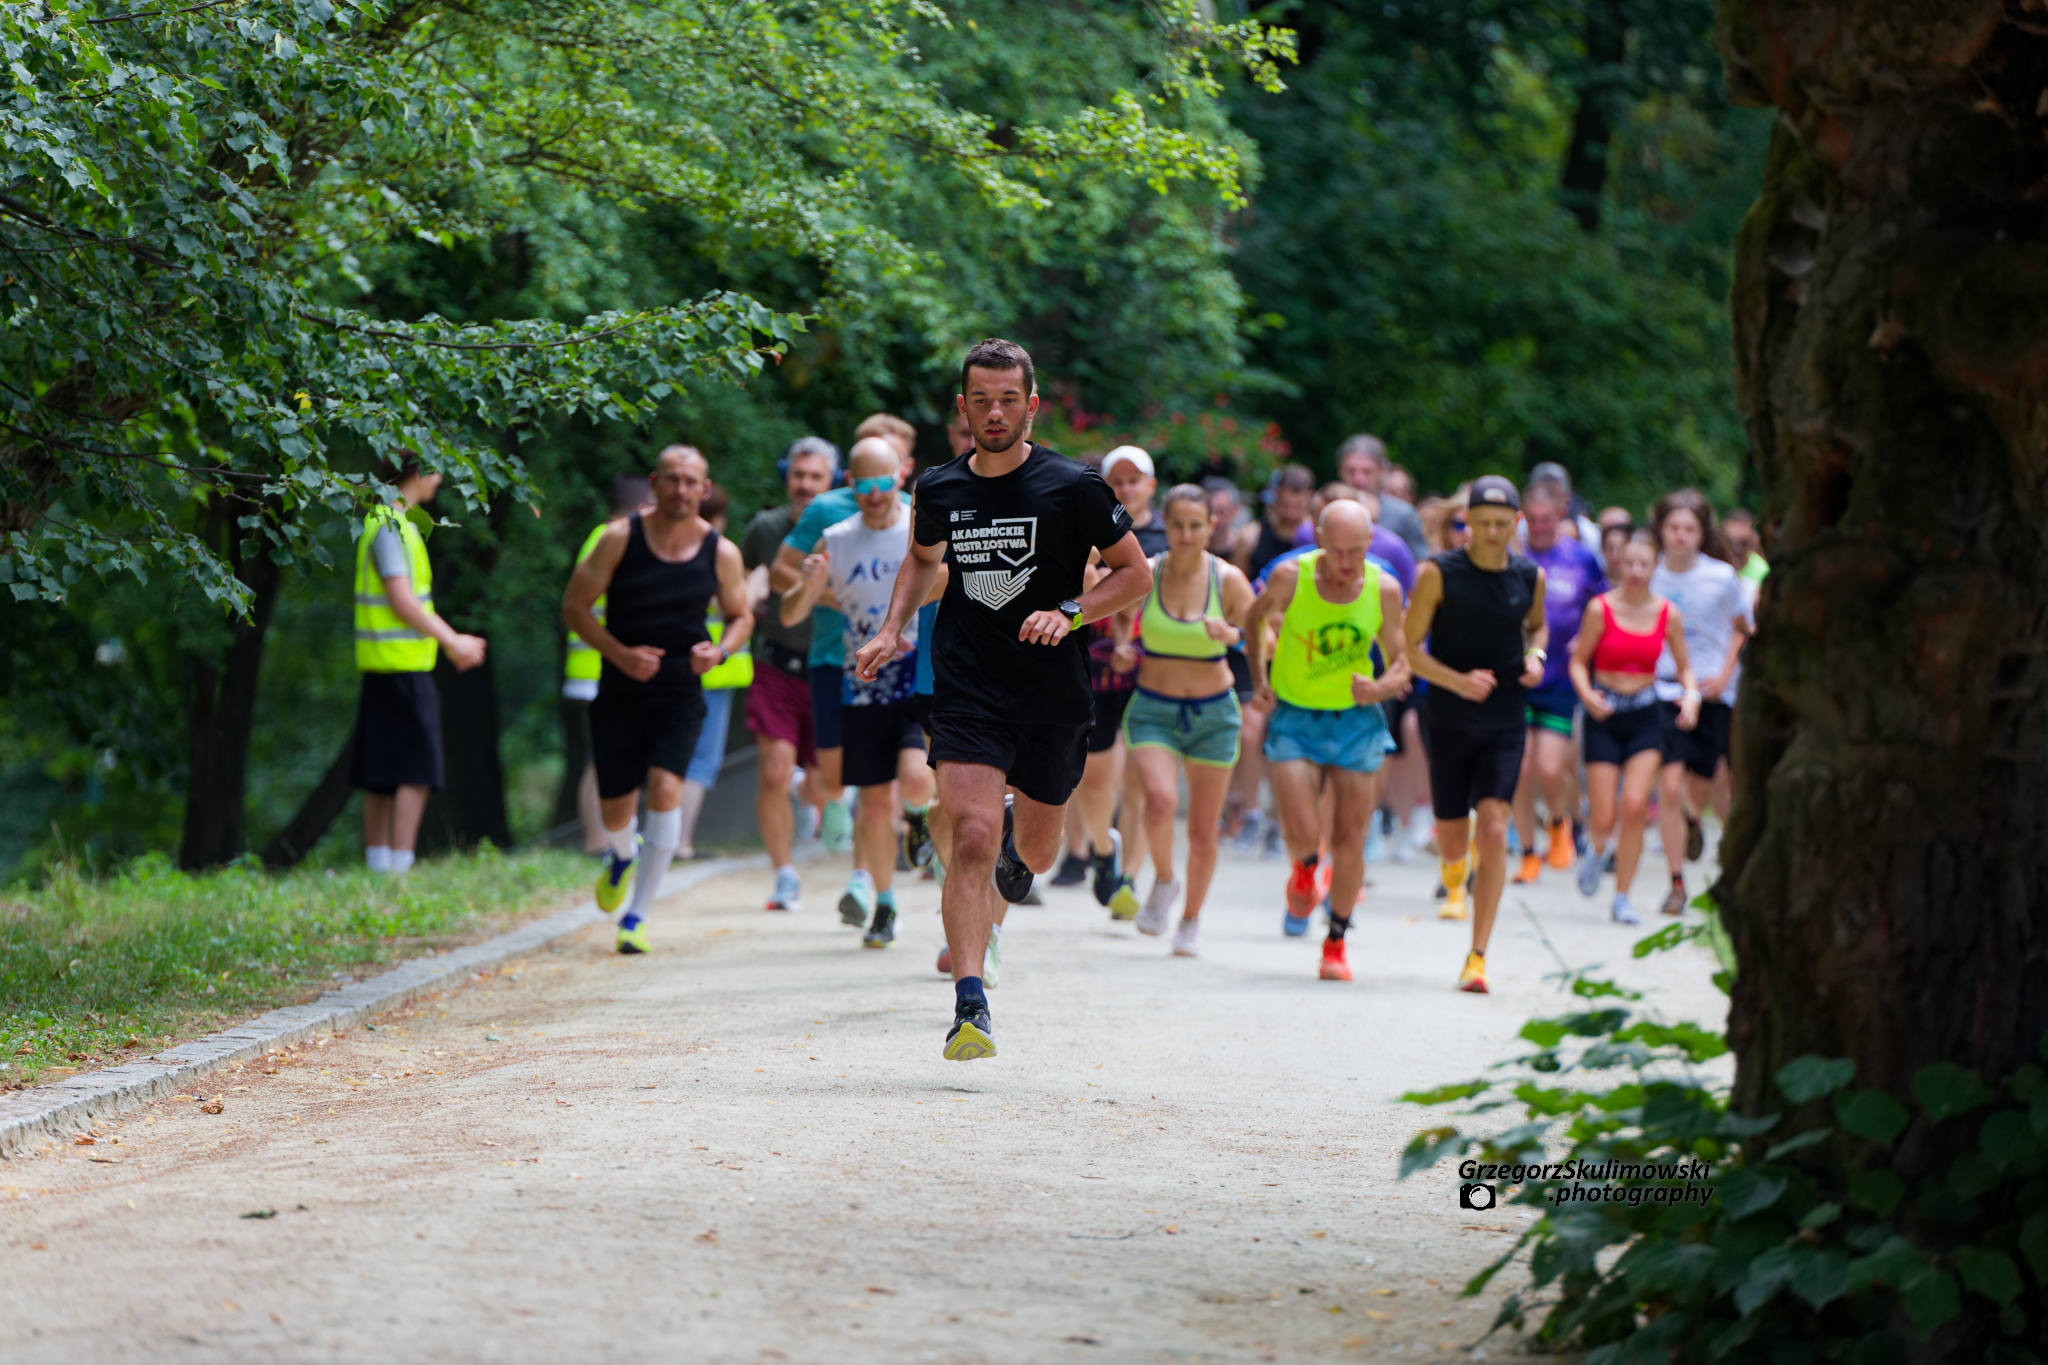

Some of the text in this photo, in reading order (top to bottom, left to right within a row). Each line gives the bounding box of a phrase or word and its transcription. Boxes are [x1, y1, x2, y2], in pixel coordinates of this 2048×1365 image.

[952, 526, 1025, 540] AKADEMICKIE
[953, 539, 1028, 552] MISTRZOSTWA
[956, 552, 991, 564] POLSKI
